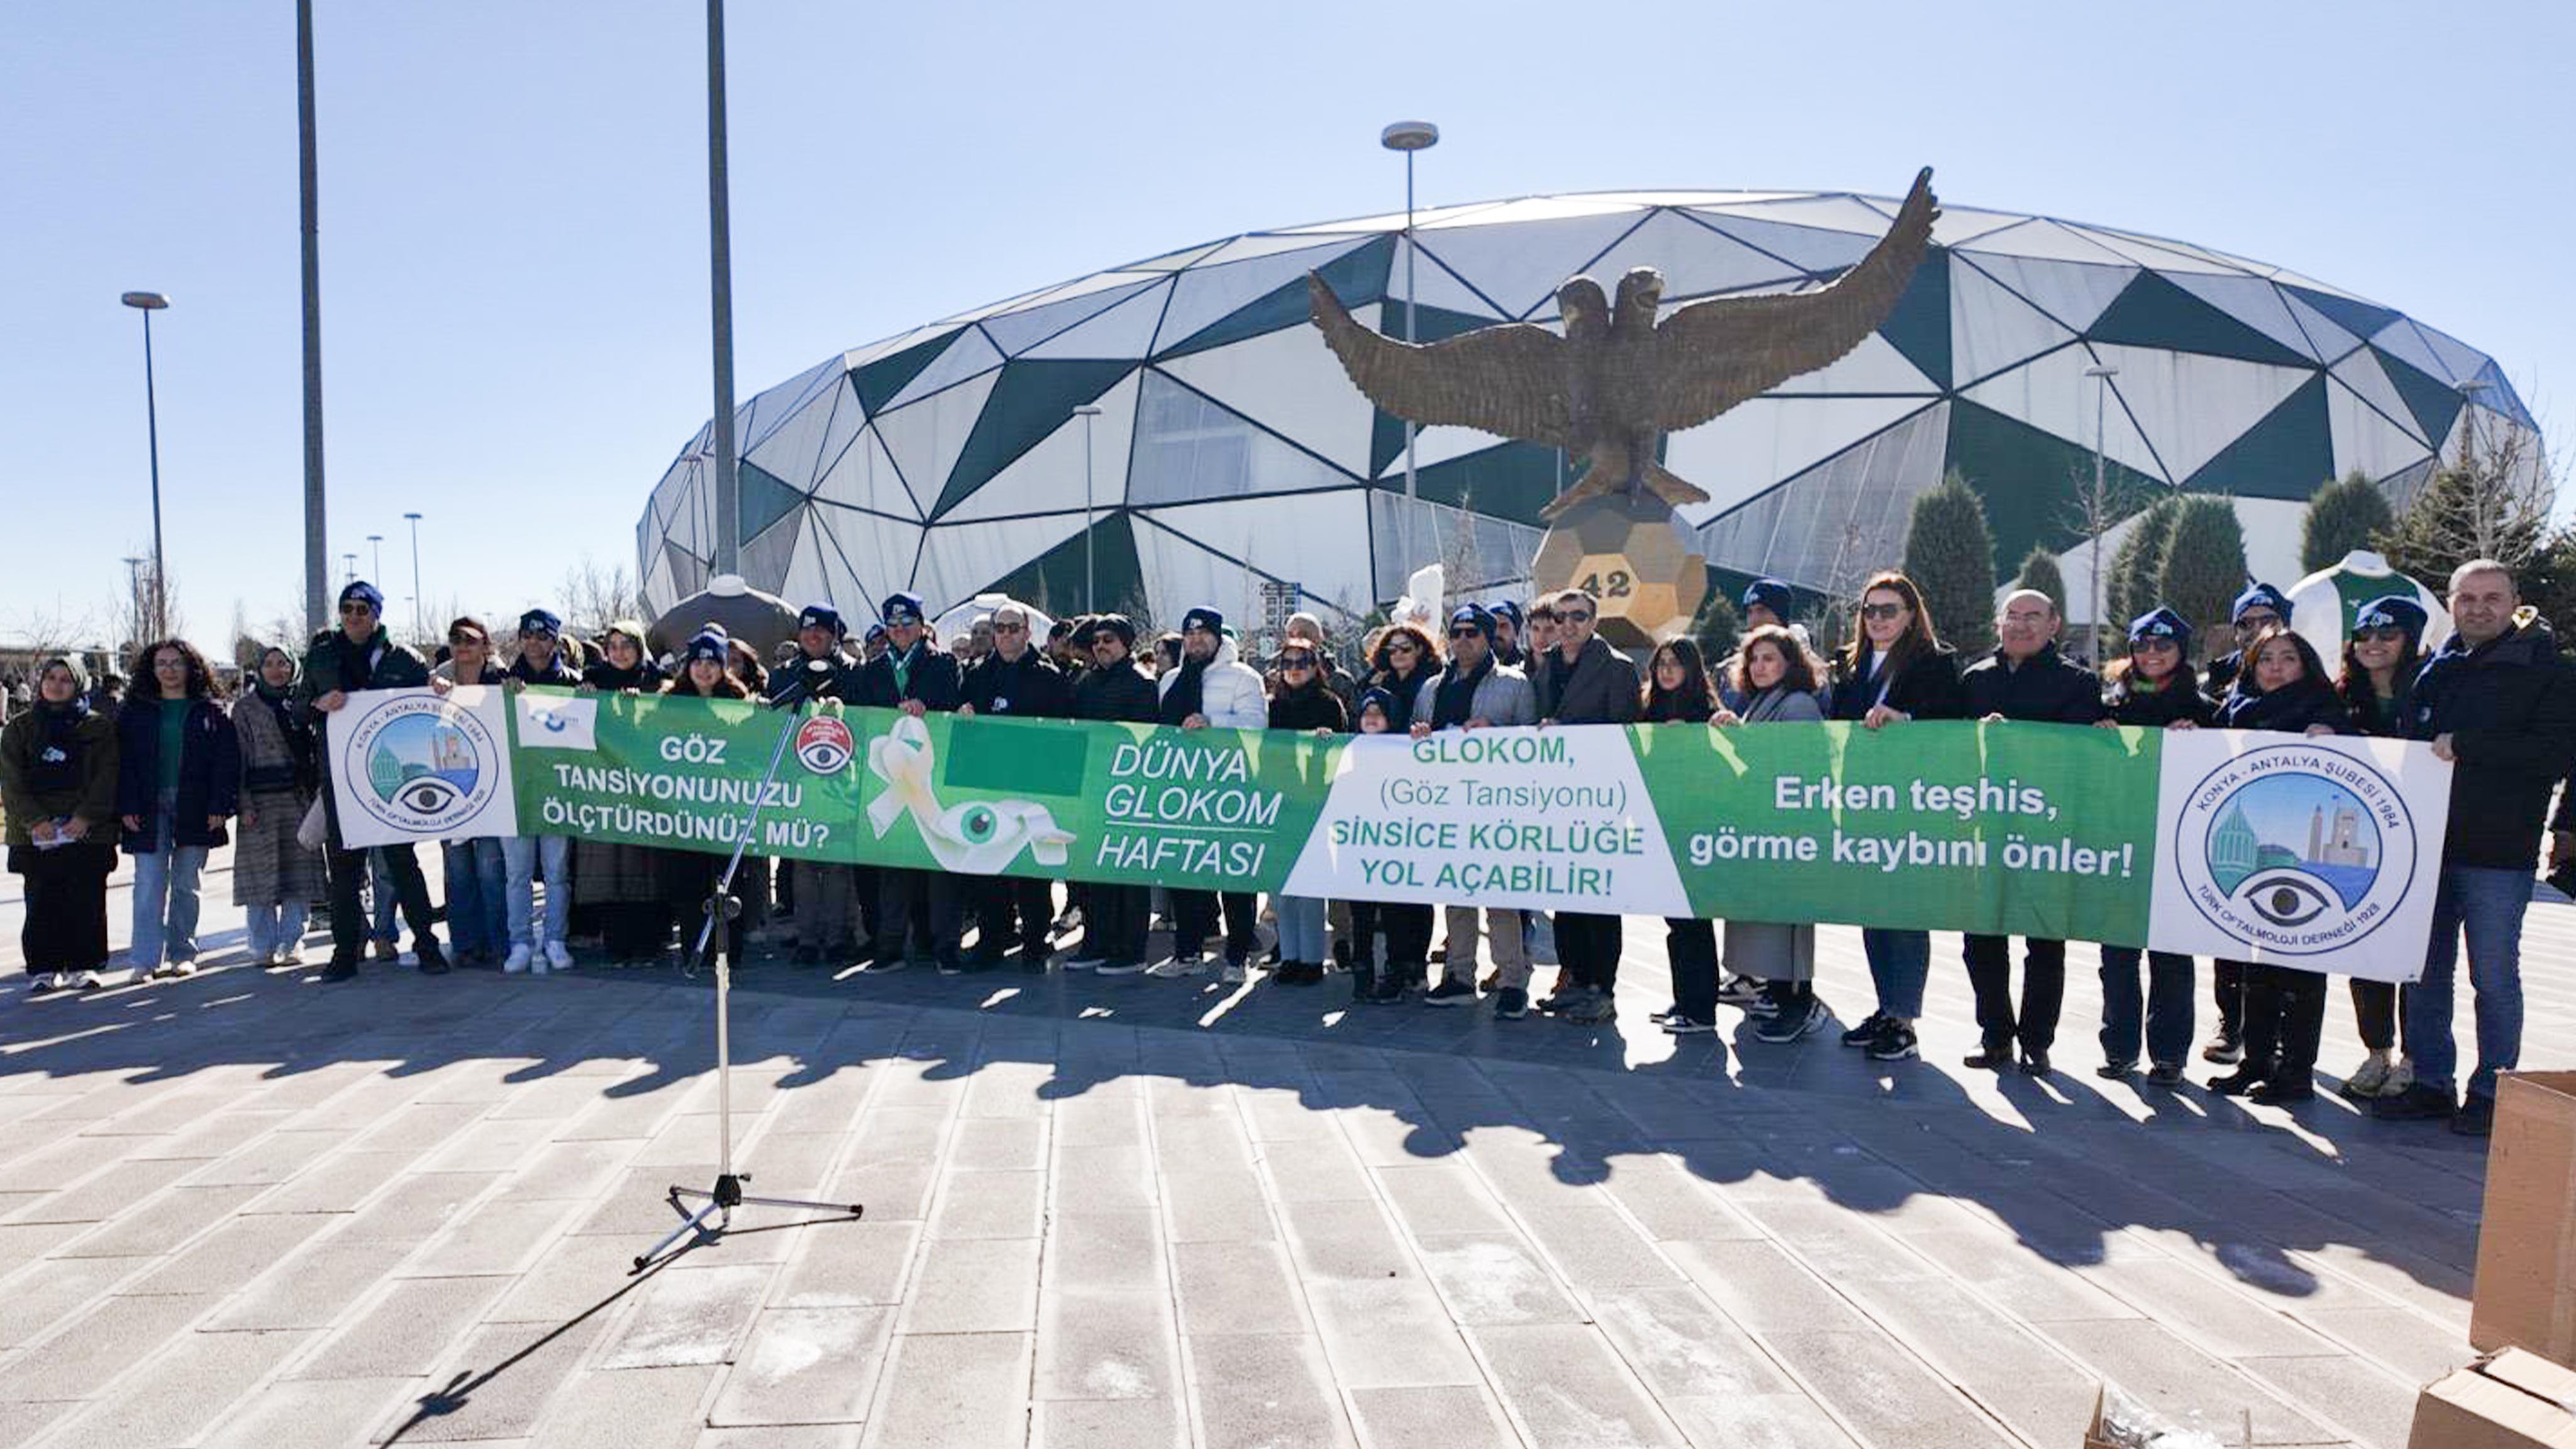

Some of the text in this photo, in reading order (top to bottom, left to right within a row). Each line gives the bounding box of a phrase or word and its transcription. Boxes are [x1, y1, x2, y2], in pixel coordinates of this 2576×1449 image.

[1579, 570, 1631, 598] 42
[660, 733, 727, 763] GÖZ
[1111, 740, 1248, 783] DÜNYA
[1413, 736, 1574, 768] GLOKOM,
[553, 763, 802, 808] TANSİYONUNUZU
[1105, 784, 1283, 825] GLOKOM
[1380, 777, 1627, 815] (Göz Tansiyonu)
[1774, 775, 2059, 821] Erken teşhis,
[2196, 772, 2240, 812] KONYA
[2250, 755, 2320, 774] ANTALYA
[2324, 760, 2377, 799] ŞUBESİ
[543, 797, 830, 848] ÖLÇTÜRDÜNÜZ MÜ?
[1331, 815, 1645, 855] SİNSİCE KÖRLÜĞE
[1096, 833, 1266, 877] HAFTASI
[1689, 826, 2134, 877] görme kaybını önler!
[1360, 858, 1613, 897] YOL AÇABİLİR!
[2197, 884, 2221, 913] TÜRK
[2221, 909, 2299, 946] OFTALMOLOJİ
[2302, 919, 2357, 945] DERNEĞİ
